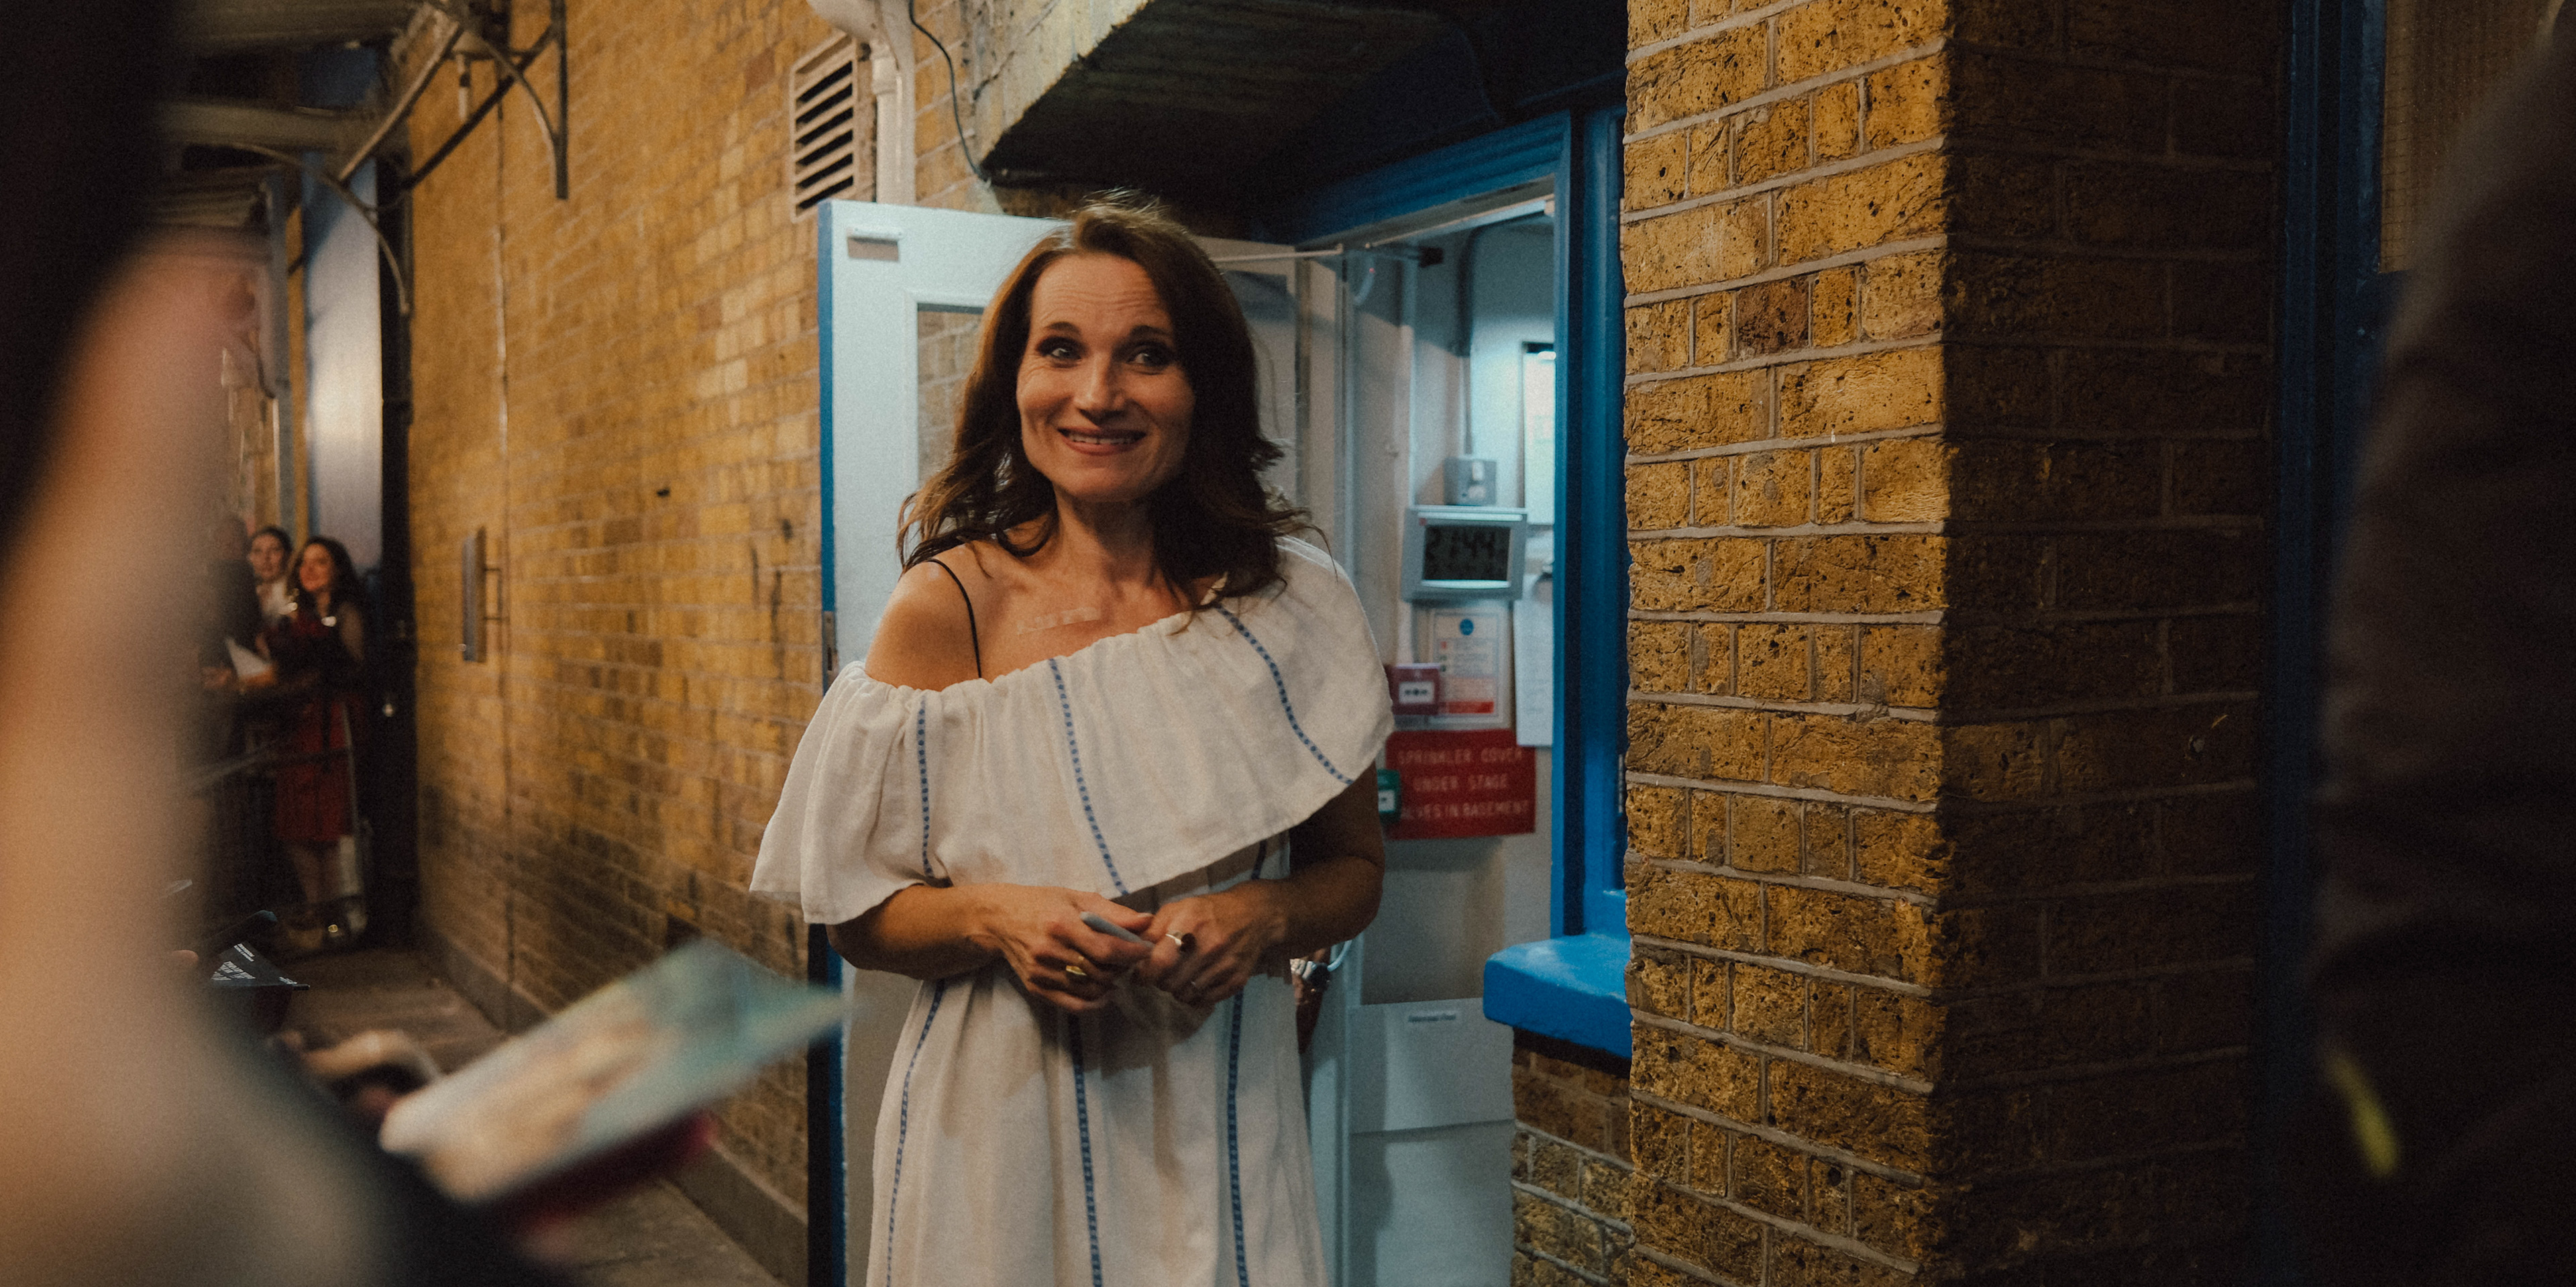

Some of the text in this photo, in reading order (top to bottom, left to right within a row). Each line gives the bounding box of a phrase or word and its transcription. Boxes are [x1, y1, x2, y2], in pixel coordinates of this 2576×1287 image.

[1398, 746, 1523, 765] SPRINKLER COVER
[1413, 773, 1508, 792] UNDER STAGE
[1401, 799, 1529, 820] ALVES IN BASEMENT
